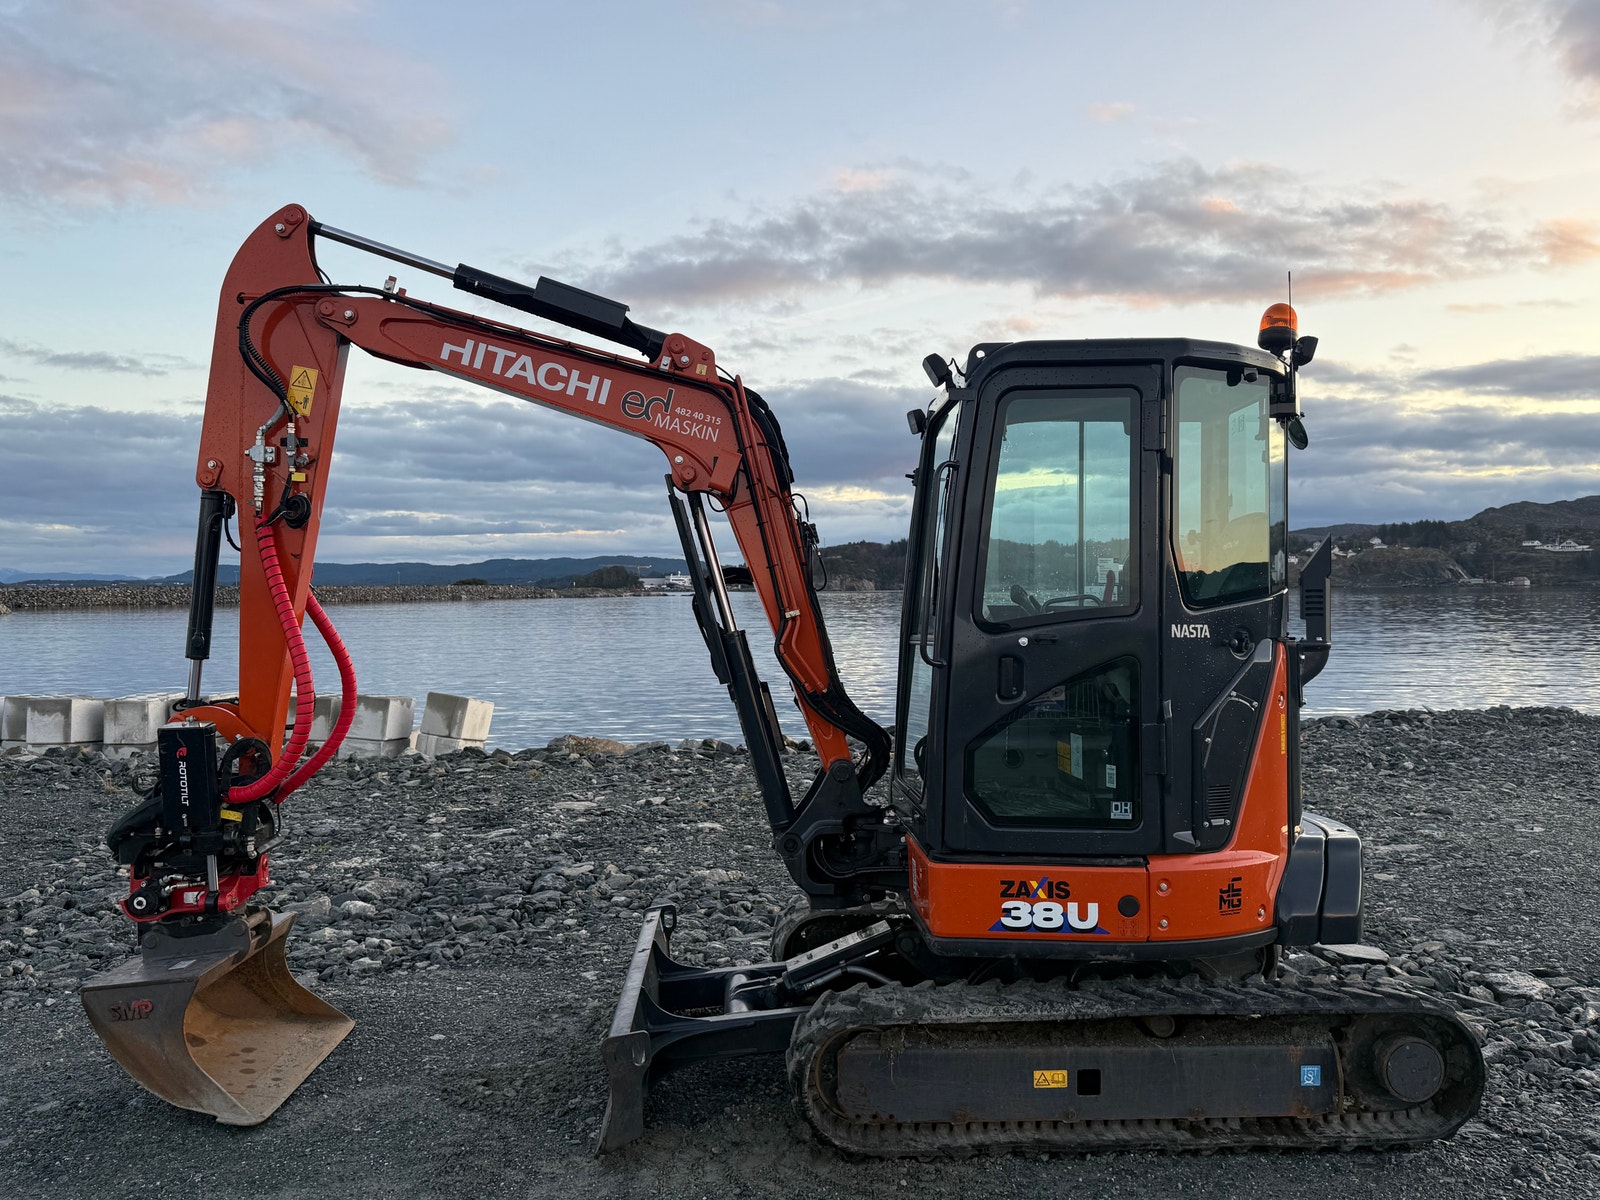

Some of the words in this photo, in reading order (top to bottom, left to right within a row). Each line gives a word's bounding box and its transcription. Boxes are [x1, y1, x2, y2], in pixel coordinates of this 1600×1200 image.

[441, 339, 612, 405] HITACHI
[654, 413, 719, 442] MASKIN
[674, 406, 691, 417] 482
[692, 411, 704, 420] 40
[705, 414, 722, 425] 315
[1171, 624, 1210, 638] NASTA
[178, 761, 189, 806] ROTOTILT
[1000, 877, 1071, 899] ZAXIS
[1000, 901, 1099, 932] 38U
